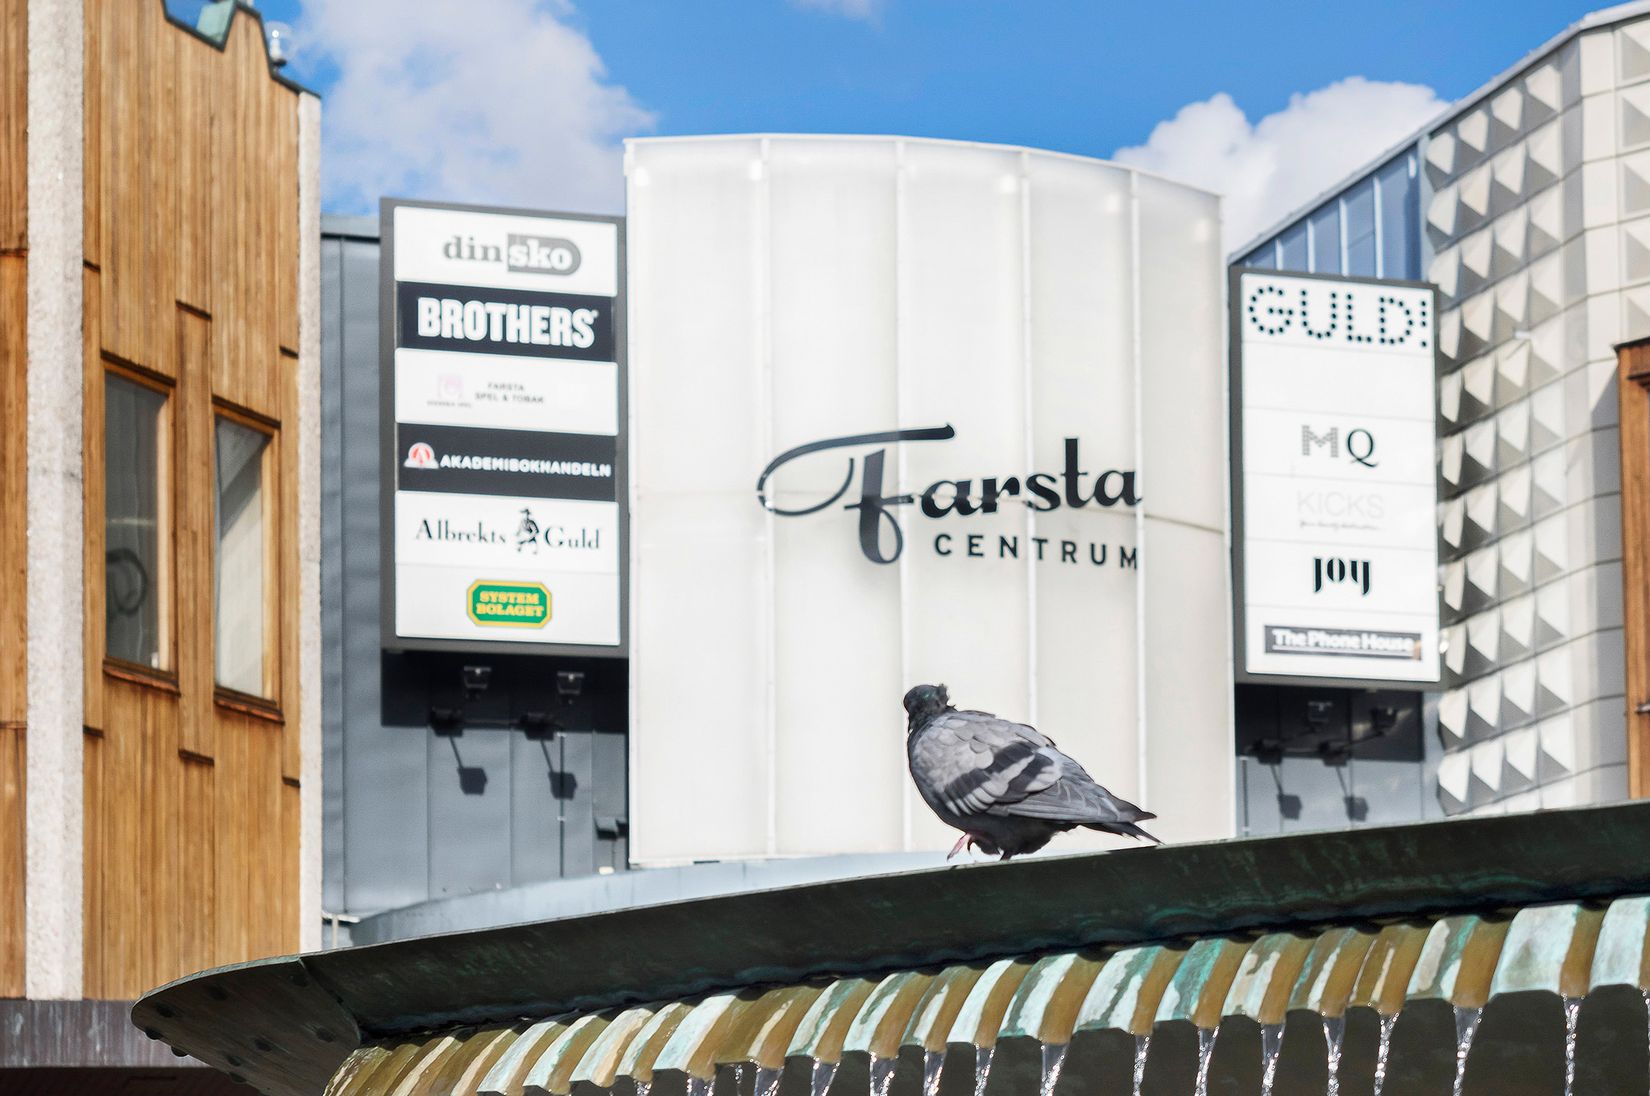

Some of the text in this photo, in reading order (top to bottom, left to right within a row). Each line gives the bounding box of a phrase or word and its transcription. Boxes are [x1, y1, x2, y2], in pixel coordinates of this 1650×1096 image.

[417, 296, 596, 349] BROTHERS
[1248, 286, 1428, 348] GULD!
[1301, 424, 1379, 468] MQ
[440, 454, 612, 477] AKADEMIBOKHANDELN
[756, 423, 1142, 564] Farsta
[1296, 490, 1385, 519] KICKS
[416, 519, 601, 549] Albrekts Guld
[934, 533, 1139, 570] CENTRUM
[476, 603, 544, 617] BOLAGET
[479, 591, 540, 605] SYSTEM
[1272, 629, 1415, 651] The Phone House
